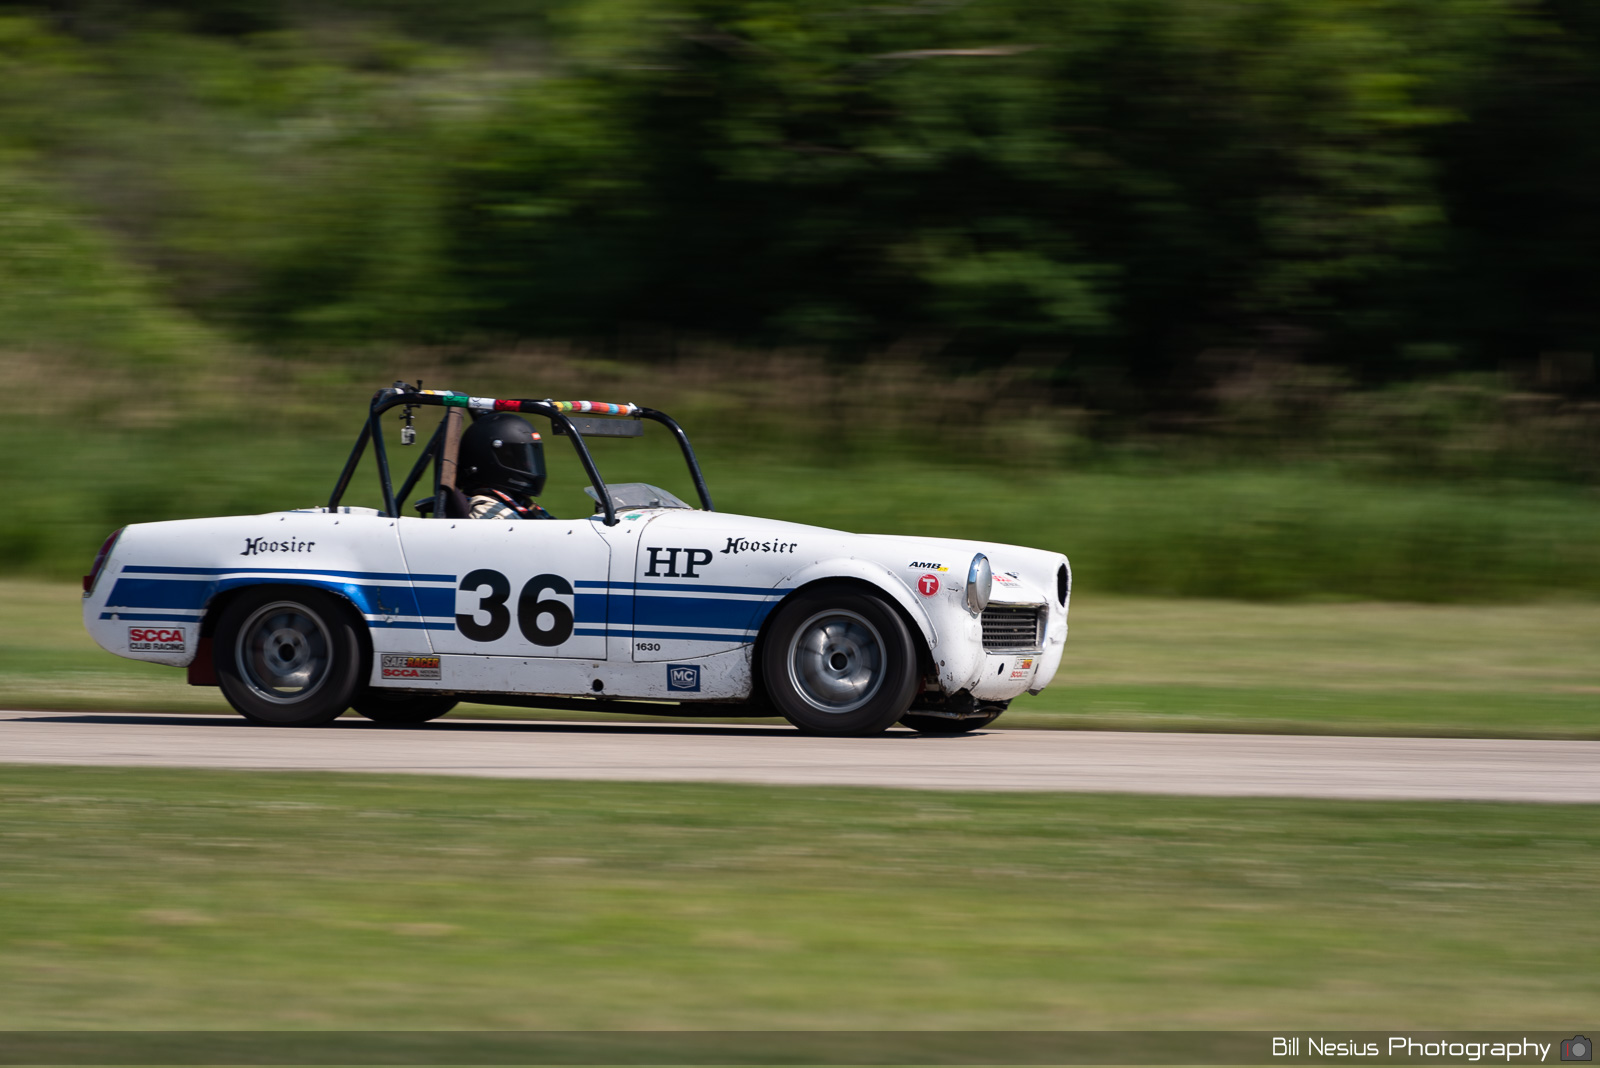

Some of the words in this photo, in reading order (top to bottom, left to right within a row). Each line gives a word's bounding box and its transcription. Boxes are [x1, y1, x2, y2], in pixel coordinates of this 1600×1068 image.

[240, 536, 316, 556] Hoosier
[720, 537, 798, 555] Hoosier
[644, 547, 713, 578] HP
[909, 561, 941, 569] AMB
[922, 578, 936, 593] T
[455, 568, 575, 647] 36
[130, 629, 184, 642] SCCA
[153, 643, 185, 651] RACING
[635, 643, 661, 652] 1630
[383, 668, 420, 677] SCCA
[673, 670, 694, 681] MC
